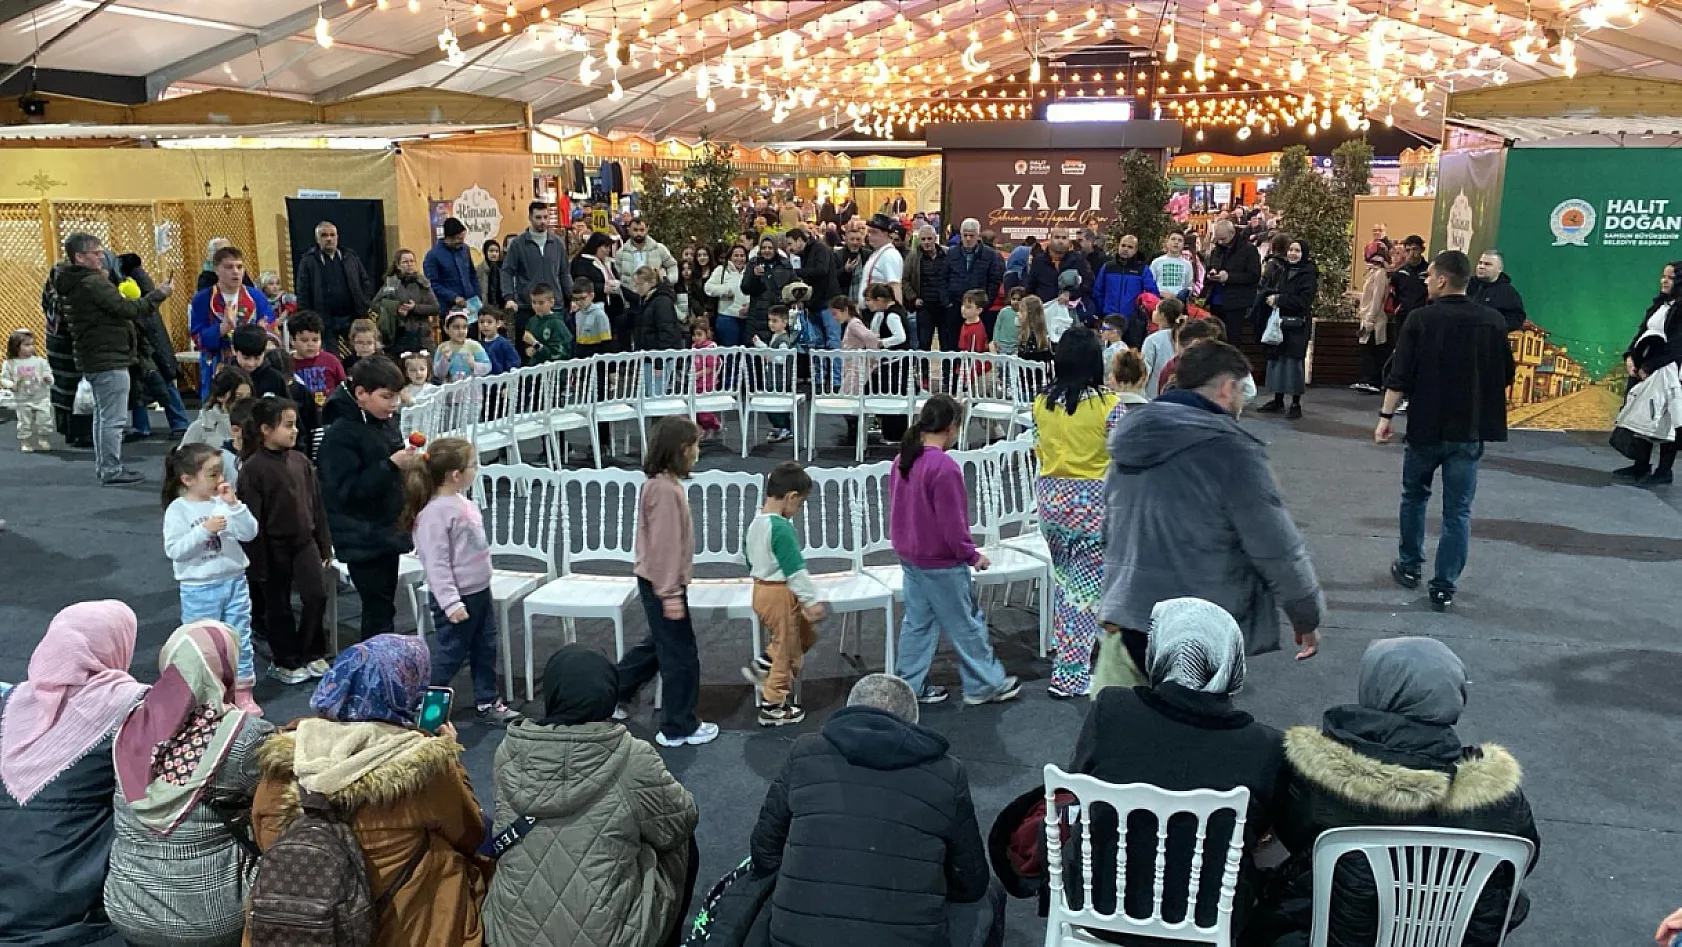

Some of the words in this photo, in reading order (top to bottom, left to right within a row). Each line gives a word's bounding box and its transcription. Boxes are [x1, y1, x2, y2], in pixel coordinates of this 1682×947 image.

[996, 184, 1103, 211] YALI
[1606, 199, 1669, 214] HALİT
[593, 214, 606, 229] 40
[1605, 214, 1682, 230] DOĞAN
